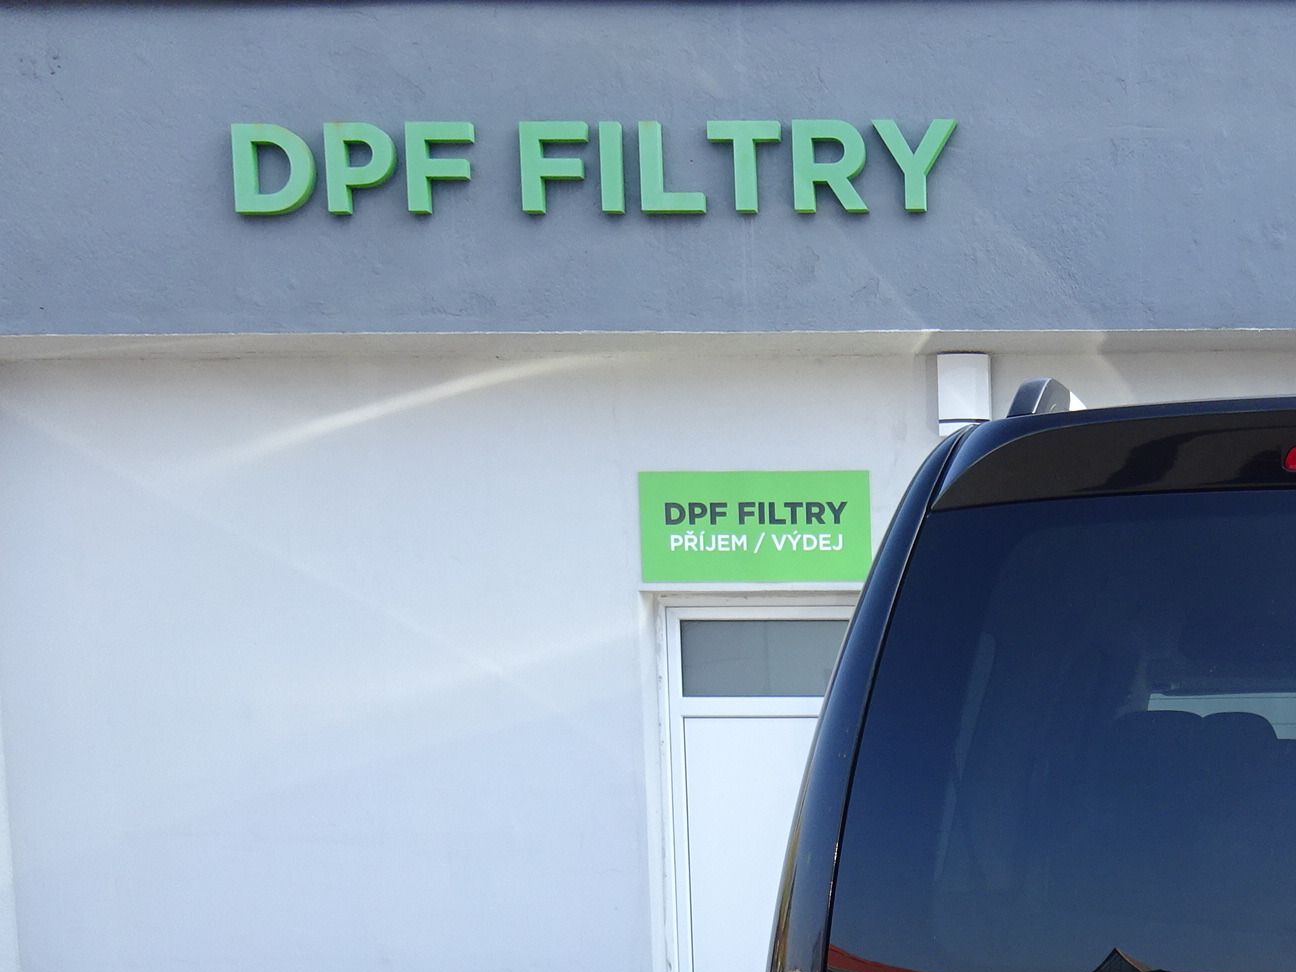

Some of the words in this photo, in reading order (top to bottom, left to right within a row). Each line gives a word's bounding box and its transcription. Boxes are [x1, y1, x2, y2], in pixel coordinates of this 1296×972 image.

[231, 120, 475, 216] DPF
[518, 118, 958, 215] FILTRY
[664, 501, 728, 526] DPF
[737, 500, 849, 526] FILTRY
[669, 529, 748, 552] PŘÍJEM
[753, 532, 766, 554] /
[771, 529, 844, 552] VÝDEJ
